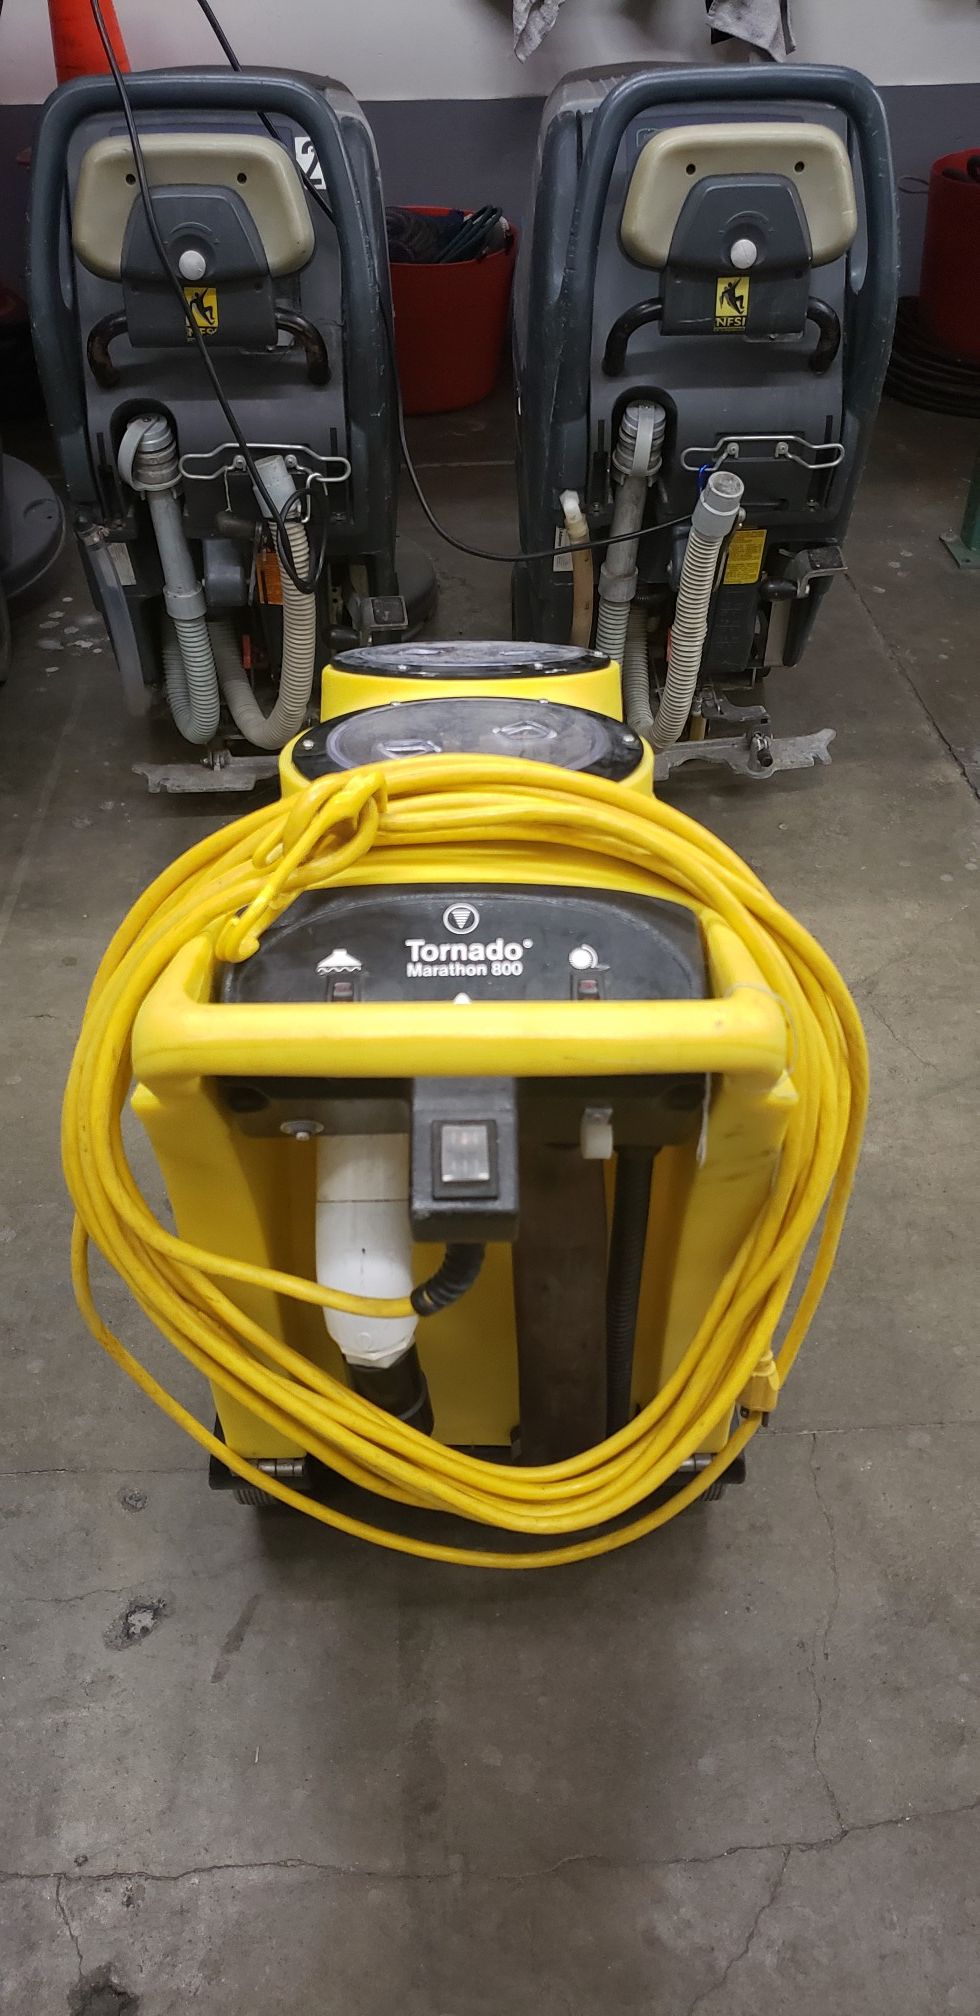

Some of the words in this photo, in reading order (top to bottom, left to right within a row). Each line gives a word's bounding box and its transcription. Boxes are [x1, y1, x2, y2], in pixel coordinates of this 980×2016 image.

[715, 316, 746, 327] NFSI
[406, 962, 488, 977] Marathon
[490, 960, 523, 976] 800
